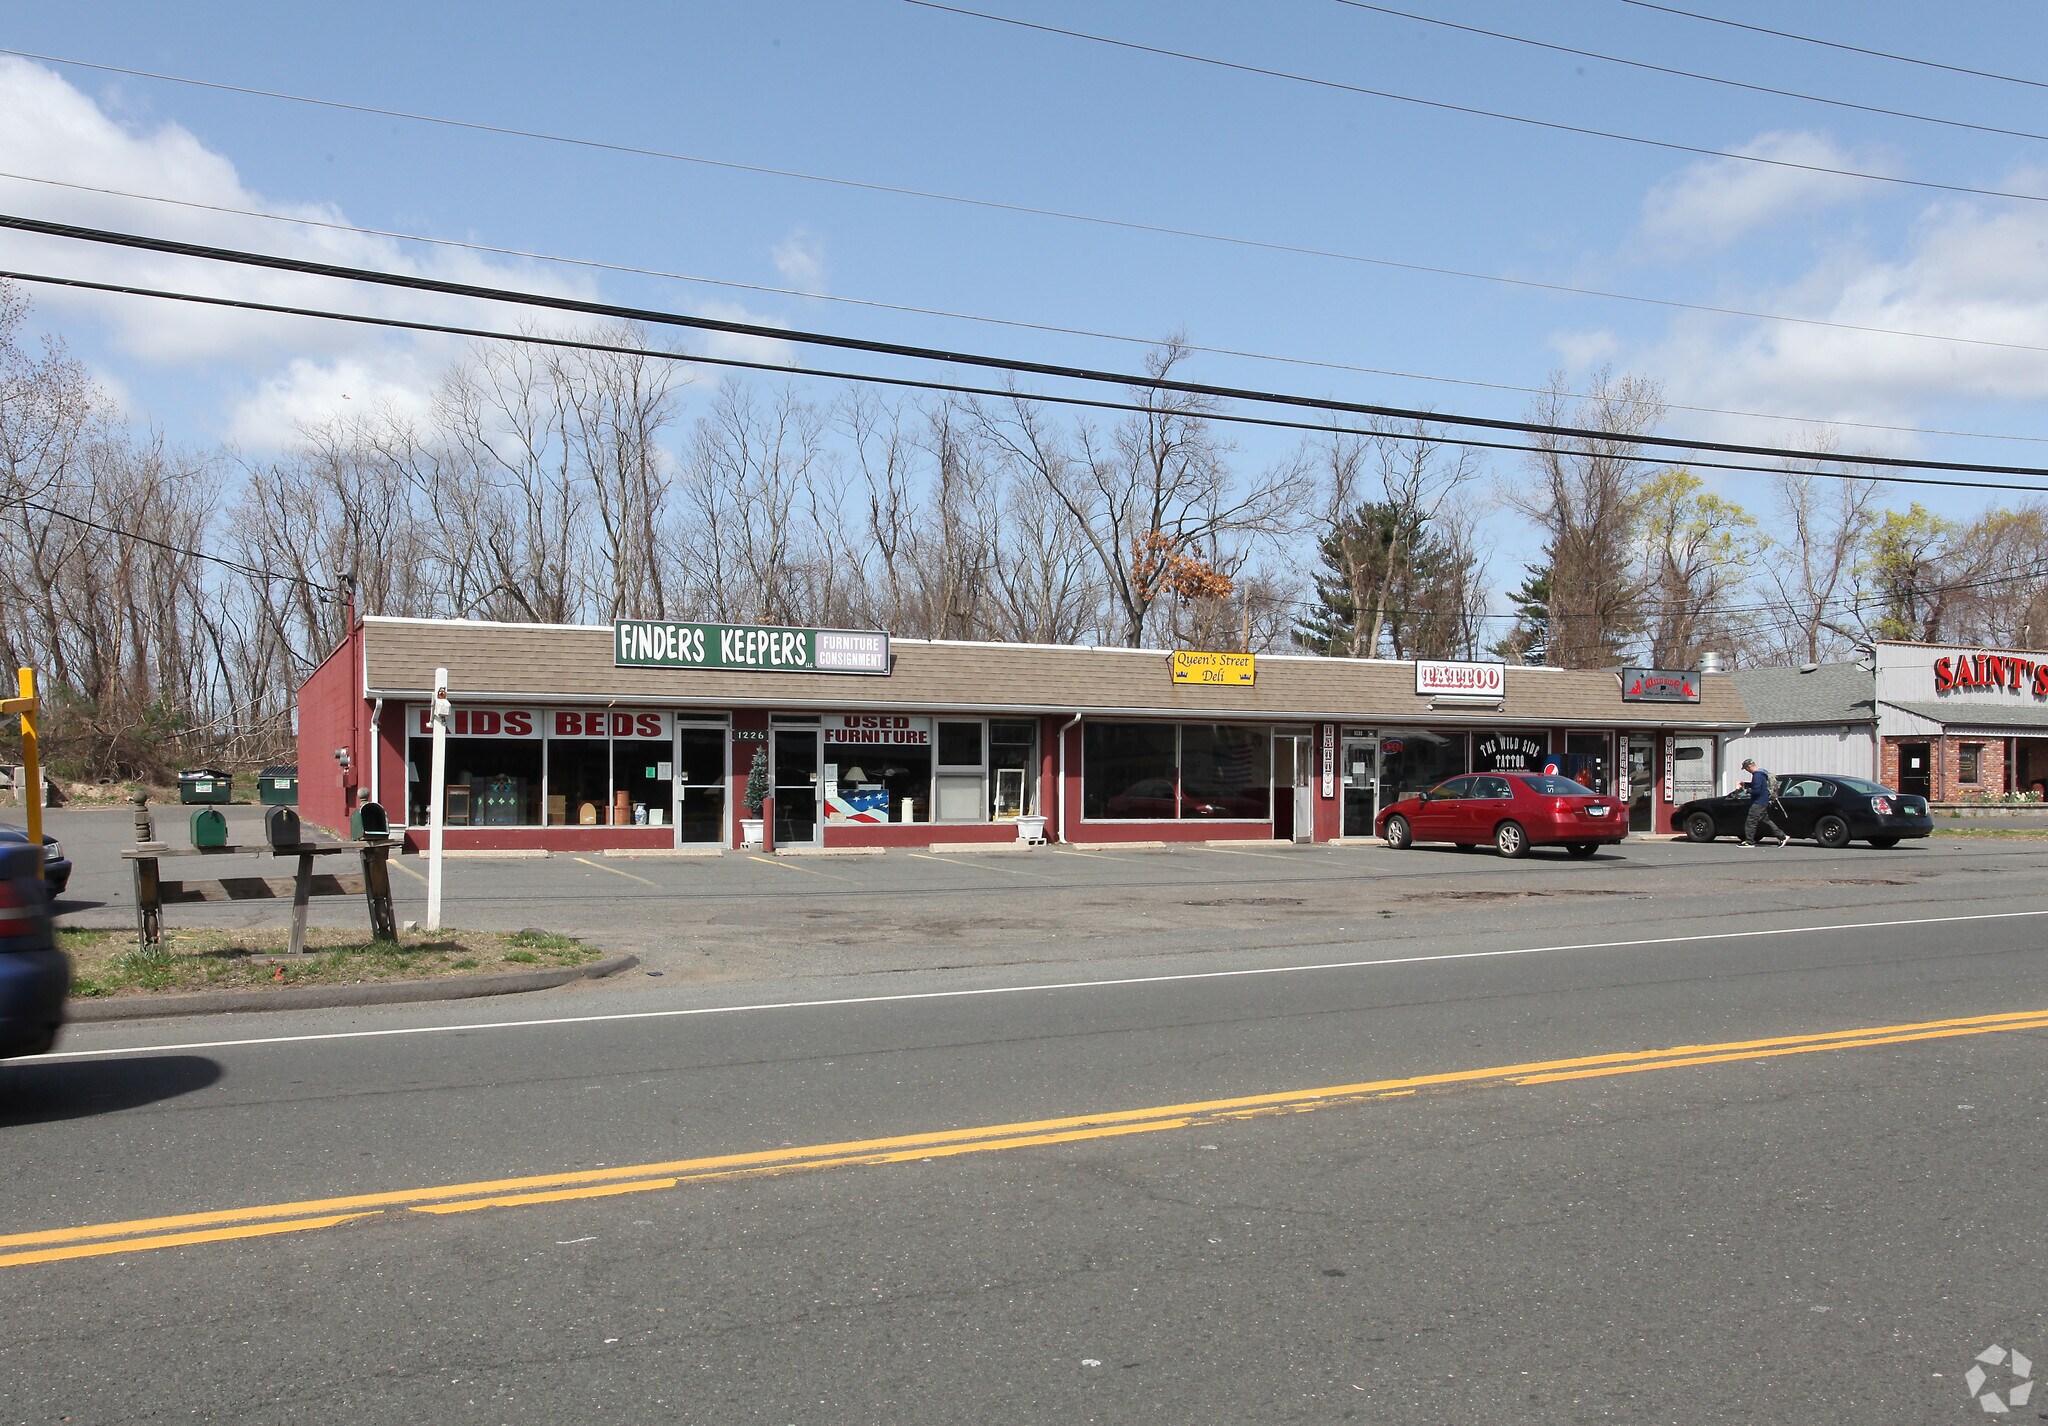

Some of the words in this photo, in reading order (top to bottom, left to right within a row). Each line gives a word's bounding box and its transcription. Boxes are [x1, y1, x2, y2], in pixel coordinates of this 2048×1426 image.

[620, 624, 705, 663] FINDERS
[720, 628, 807, 666] KEEPERS
[823, 635, 879, 651] FURNITURE
[819, 652, 882, 667] CONSIGNMENT
[1177, 652, 1217, 668] Queen's
[1219, 654, 1249, 667] Street
[1202, 668, 1225, 682] Deli
[1422, 665, 1500, 690] TATTOO
[1934, 654, 2048, 695] SAINT'S
[555, 711, 662, 737] BEDS
[844, 716, 910, 729] USED
[738, 731, 764, 740] 1226
[824, 729, 928, 744] FURNITURE
[1381, 742, 1403, 753] OPEN
[1479, 739, 1497, 757] THE
[1499, 736, 1519, 751] WILD
[1522, 739, 1541, 758] SIDE
[1324, 725, 1333, 796] TATTOO
[1495, 754, 1525, 768] TATTOO
